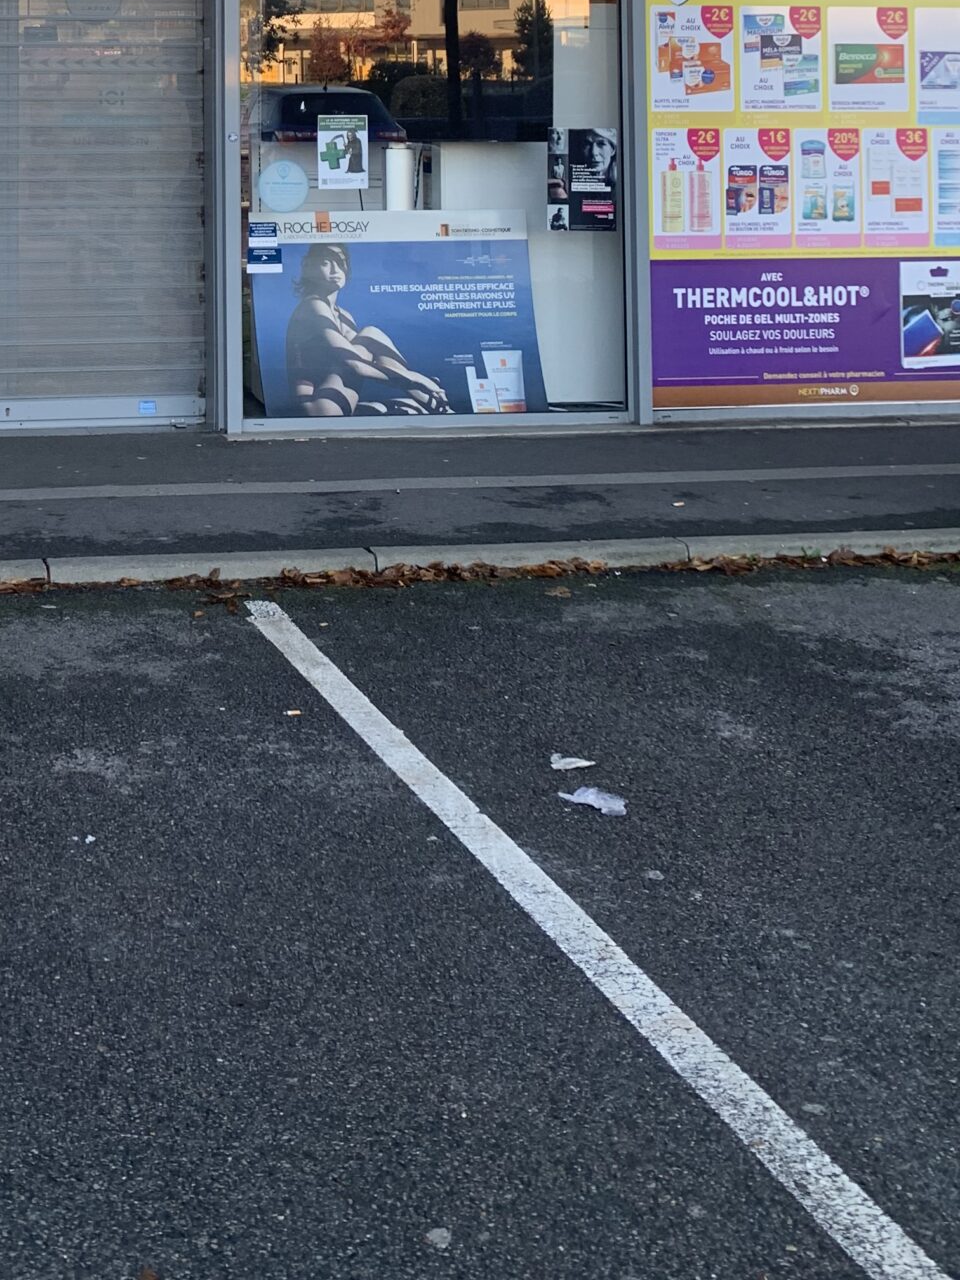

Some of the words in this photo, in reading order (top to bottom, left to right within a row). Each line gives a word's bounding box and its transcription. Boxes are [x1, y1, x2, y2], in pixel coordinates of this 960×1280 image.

[705, 8, 729, 20] -2€
[793, 9, 817, 21] -2€
[881, 11, 904, 23] -2€
[691, 131, 716, 144] -2€
[762, 131, 786, 143] -1€
[829, 132, 858, 144] -20%
[900, 131, 924, 144] -3€
[760, 272, 784, 282] AVEC
[370, 284, 380, 292] LE
[381, 284, 408, 292] FILTRE
[409, 284, 442, 292] SOLAIRE
[456, 283, 476, 291] PLUS
[476, 282, 514, 290] EFFICACE
[420, 293, 454, 301] CONTRE
[455, 292, 470, 300] LES
[471, 292, 502, 300] RAYONS
[418, 302, 433, 311] QUI
[704, 314, 737, 325] POCHE
[739, 314, 752, 324] DE
[754, 314, 773, 324] GEL
[775, 313, 840, 324] MULTI-ZONES
[710, 330, 760, 341] SOULAGEZ
[762, 330, 782, 340] VOS
[784, 329, 835, 340] DOULEURS
